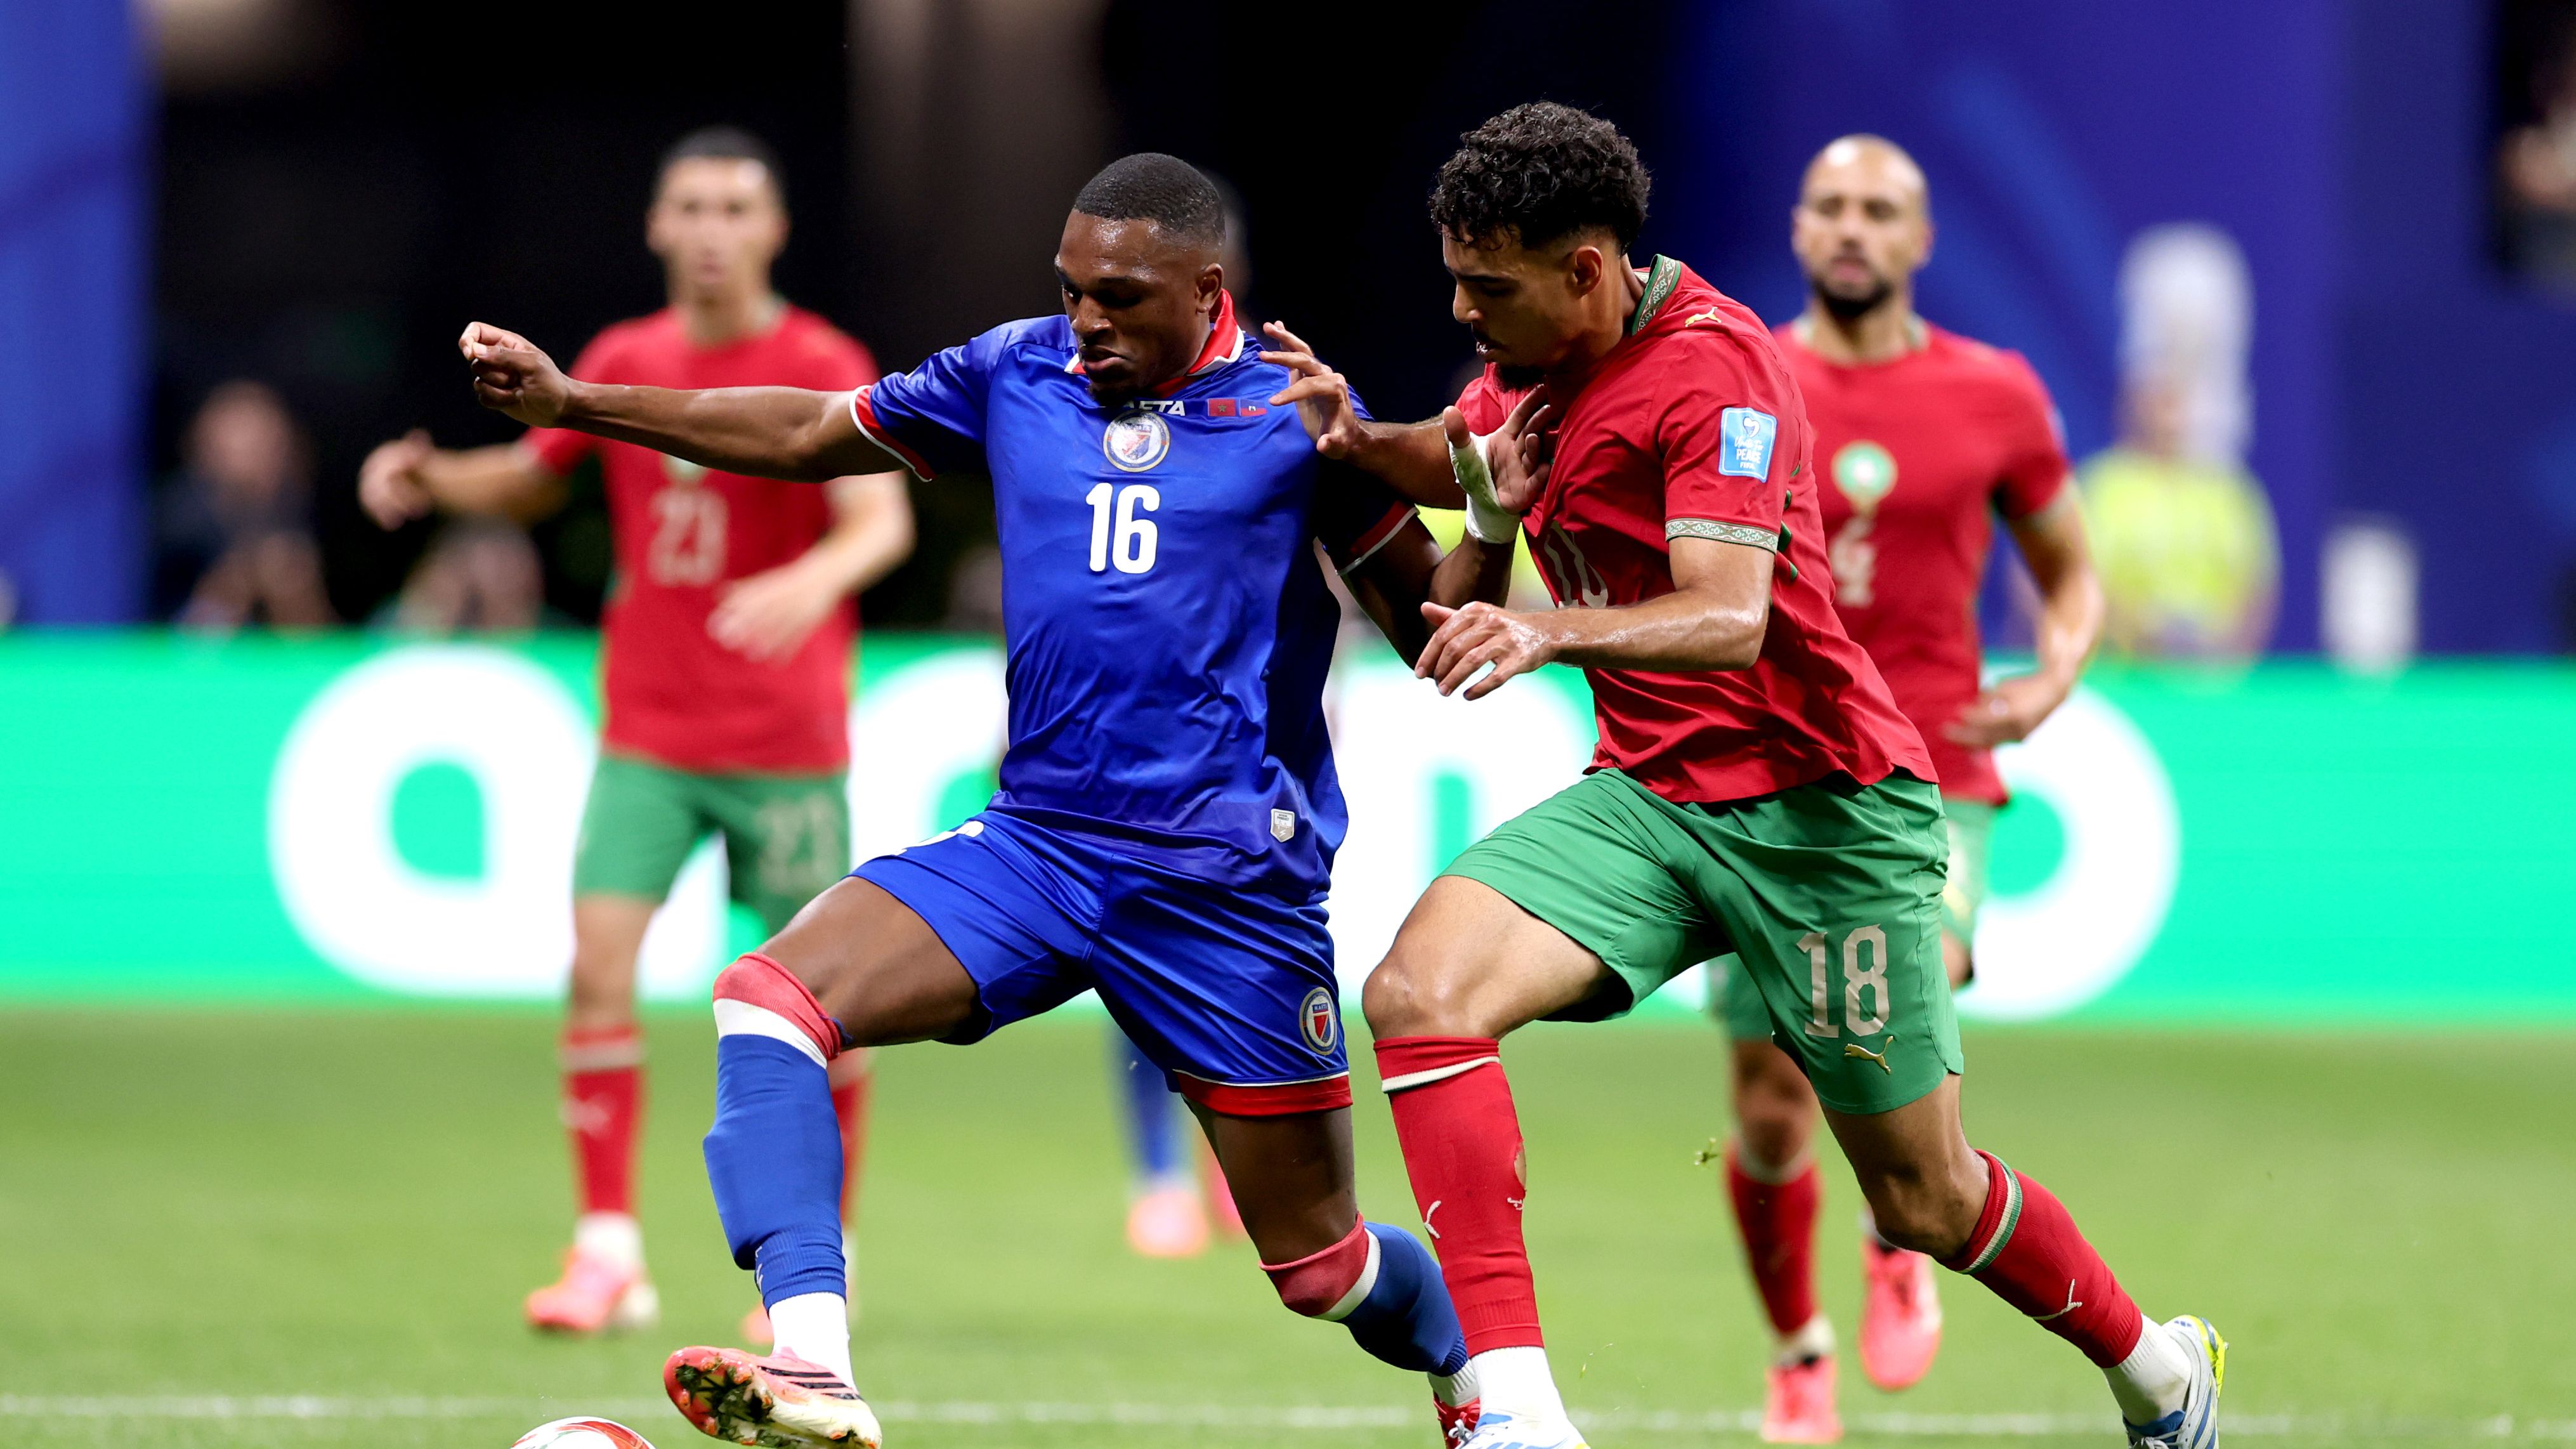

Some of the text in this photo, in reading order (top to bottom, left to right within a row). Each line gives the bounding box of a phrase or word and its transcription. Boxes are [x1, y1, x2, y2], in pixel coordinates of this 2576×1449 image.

[1736, 448, 1762, 464] PEACE
[650, 488, 729, 586] 23
[1085, 482, 1161, 574] 16
[1829, 517, 1878, 607] 4
[1796, 923, 1890, 1039] 18
